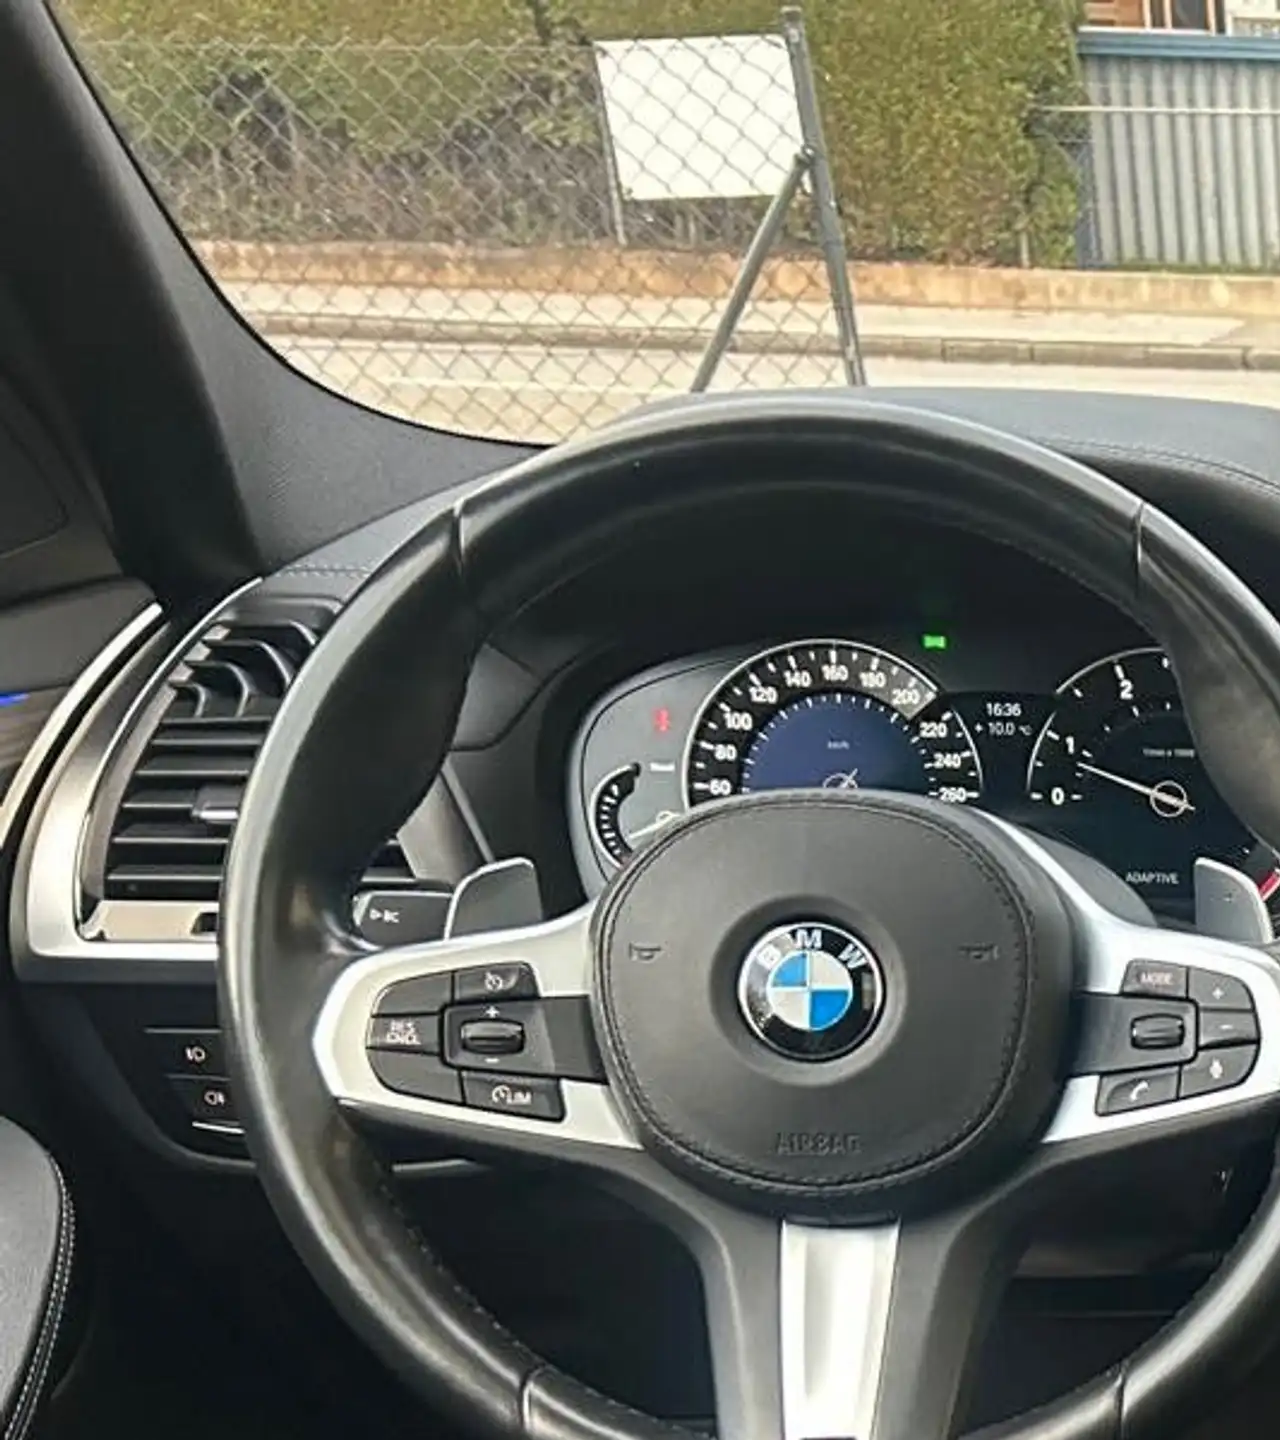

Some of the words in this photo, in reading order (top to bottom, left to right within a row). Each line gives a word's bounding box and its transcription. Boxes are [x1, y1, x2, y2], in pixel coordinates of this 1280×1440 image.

[785, 671, 811, 688] 140
[822, 665, 848, 681] 160
[860, 671, 886, 687] 180
[750, 687, 778, 704] 120
[892, 688, 920, 705] 200
[1120, 679, 1133, 699] 2
[986, 702, 1022, 717] 16:36
[724, 713, 753, 730] 100
[920, 722, 947, 738] 220
[714, 745, 737, 760] 80
[1065, 737, 1075, 754] 1
[934, 753, 962, 768] 240
[709, 780, 732, 796] 60
[939, 786, 967, 801] 260
[1051, 788, 1065, 805] 0
[1126, 871, 1179, 885] ADAPTIVE
[755, 928, 869, 970] BMW
[1140, 972, 1173, 986] MODE
